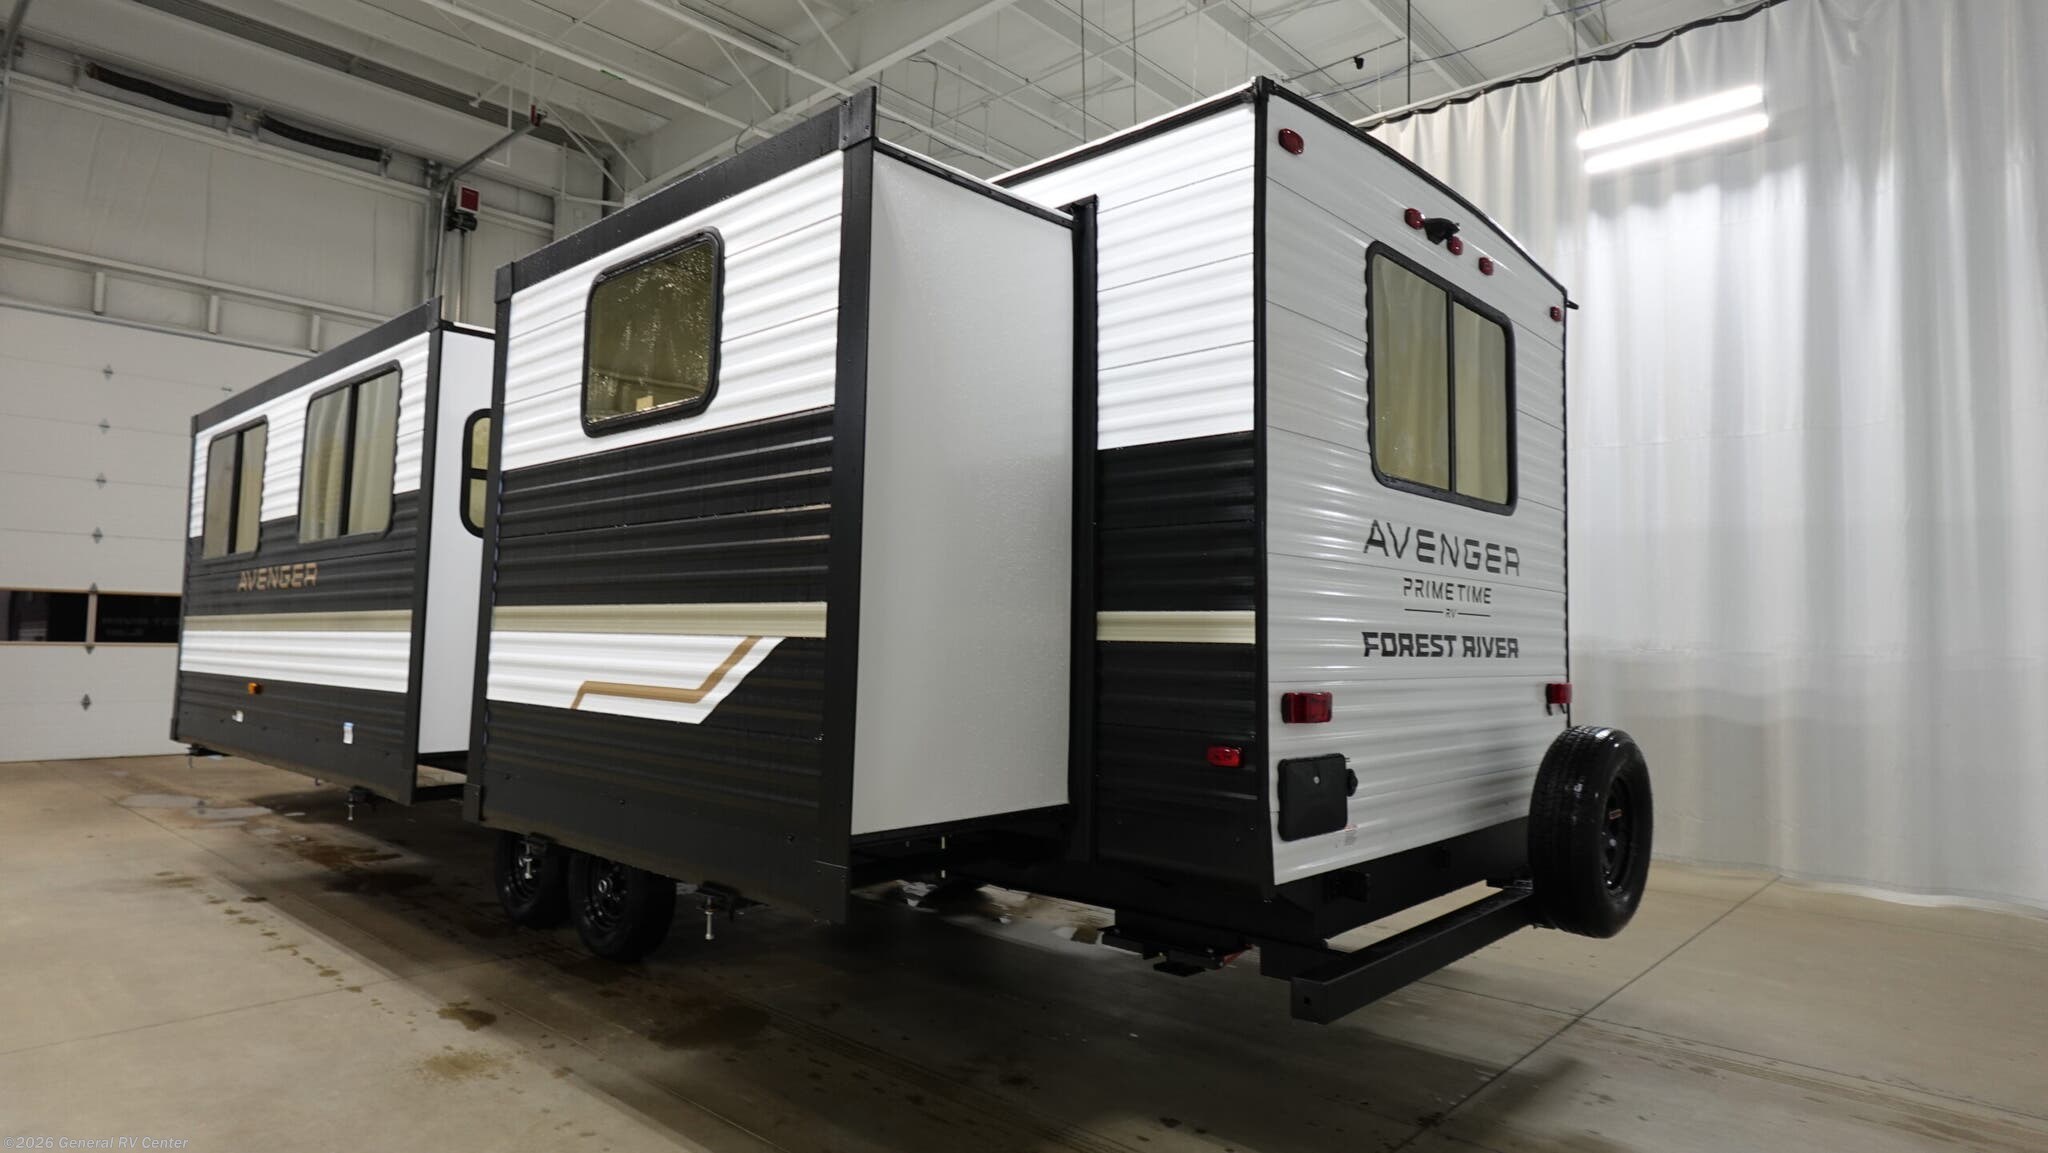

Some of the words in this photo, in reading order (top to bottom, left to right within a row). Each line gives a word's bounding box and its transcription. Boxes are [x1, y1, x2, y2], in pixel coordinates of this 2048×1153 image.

[1363, 519, 1520, 576] AVENGER
[237, 562, 319, 592] AVENGER
[1361, 631, 1457, 657] FOREST
[1461, 635, 1520, 658] RIVER
